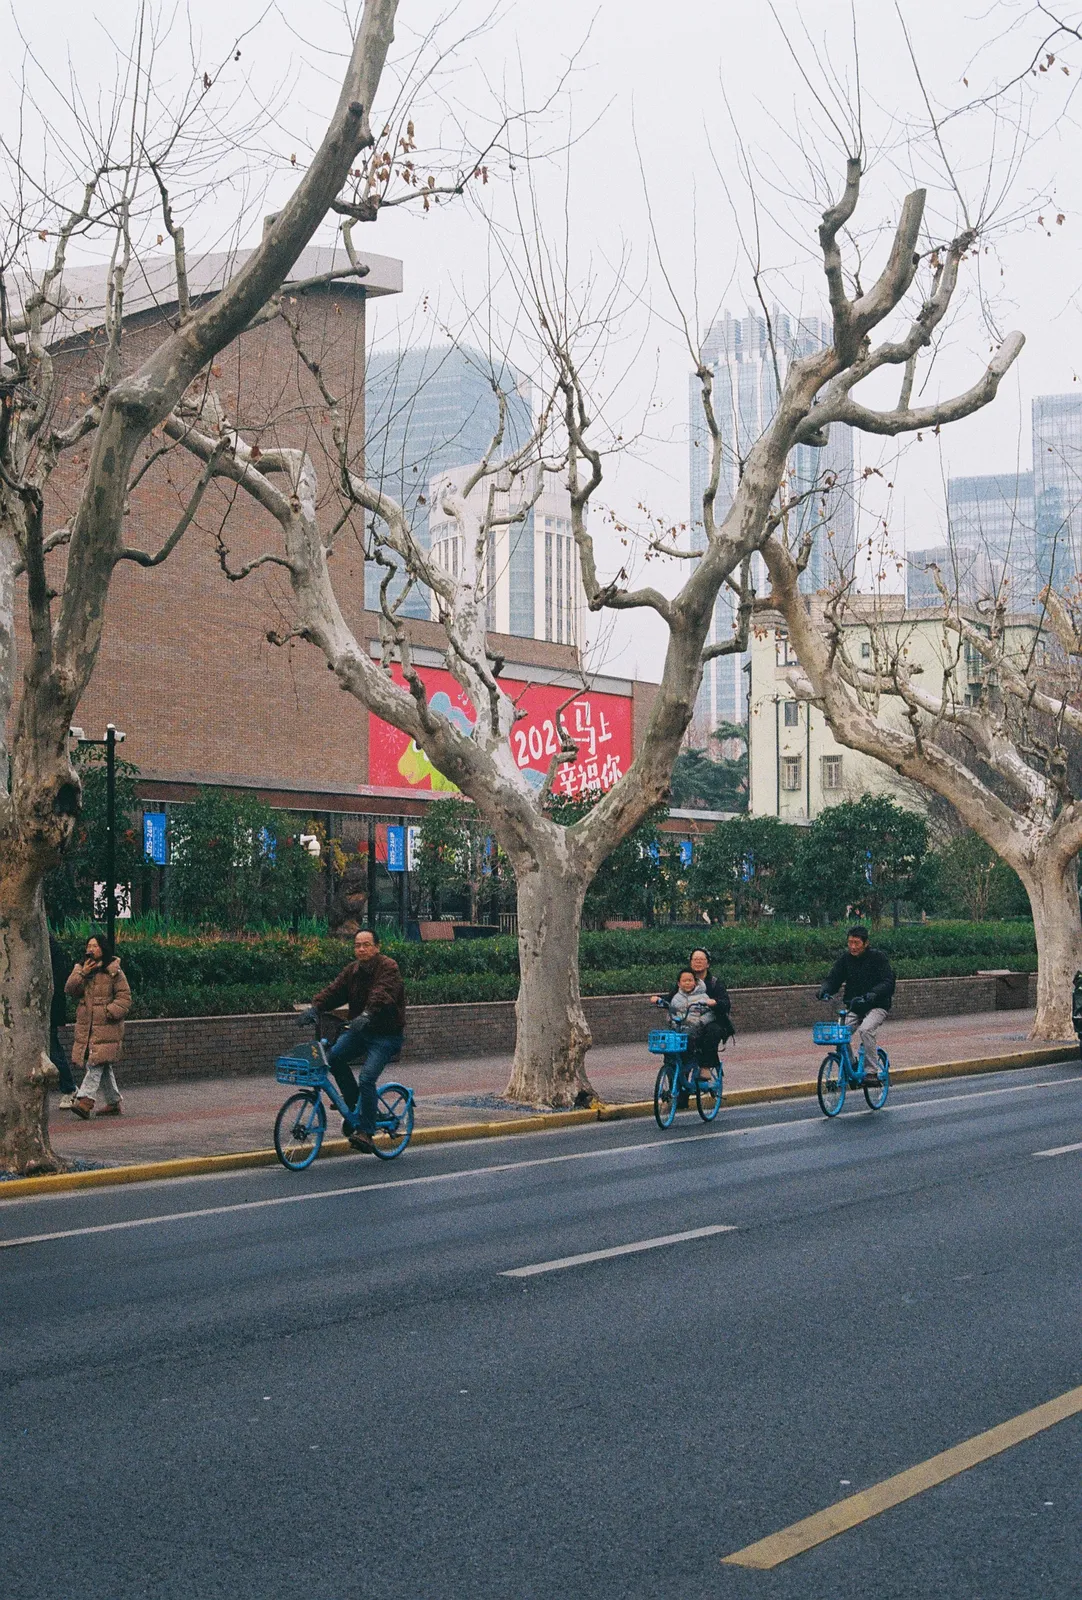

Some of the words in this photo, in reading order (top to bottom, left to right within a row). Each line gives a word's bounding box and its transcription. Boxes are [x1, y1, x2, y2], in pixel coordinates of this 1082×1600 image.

[573, 701, 612, 755] 马上
[557, 754, 623, 796] 幸福你
